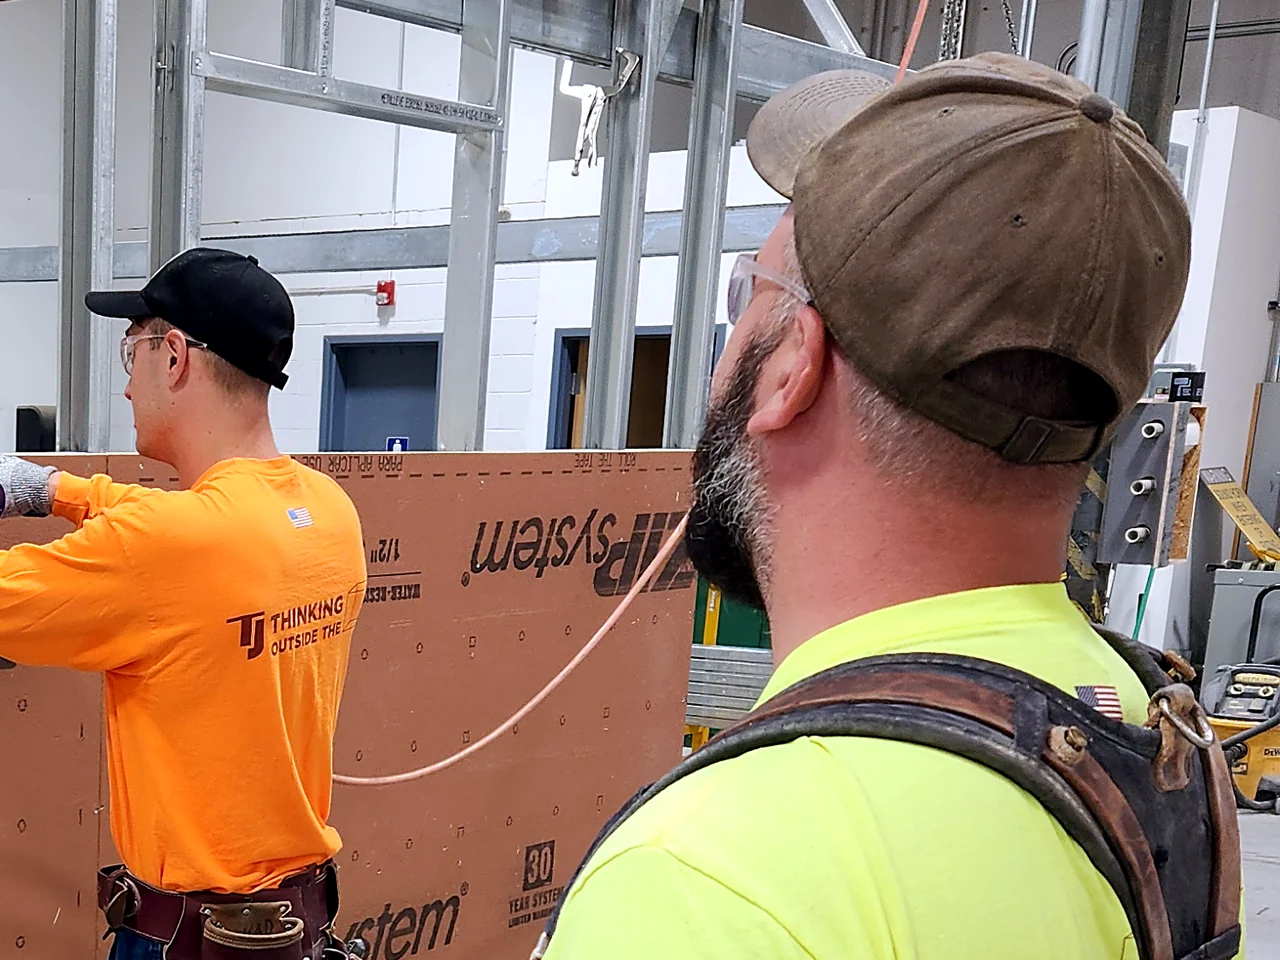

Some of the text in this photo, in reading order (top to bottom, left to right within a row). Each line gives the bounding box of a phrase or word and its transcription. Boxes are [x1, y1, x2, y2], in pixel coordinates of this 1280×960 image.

[328, 456, 373, 472] APLICAR
[378, 456, 403, 472] PARA
[370, 538, 400, 563] 1/2"
[270, 596, 344, 635] THINKING
[270, 621, 341, 657] OUTSIDE THE
[508, 896, 530, 915] YEAR
